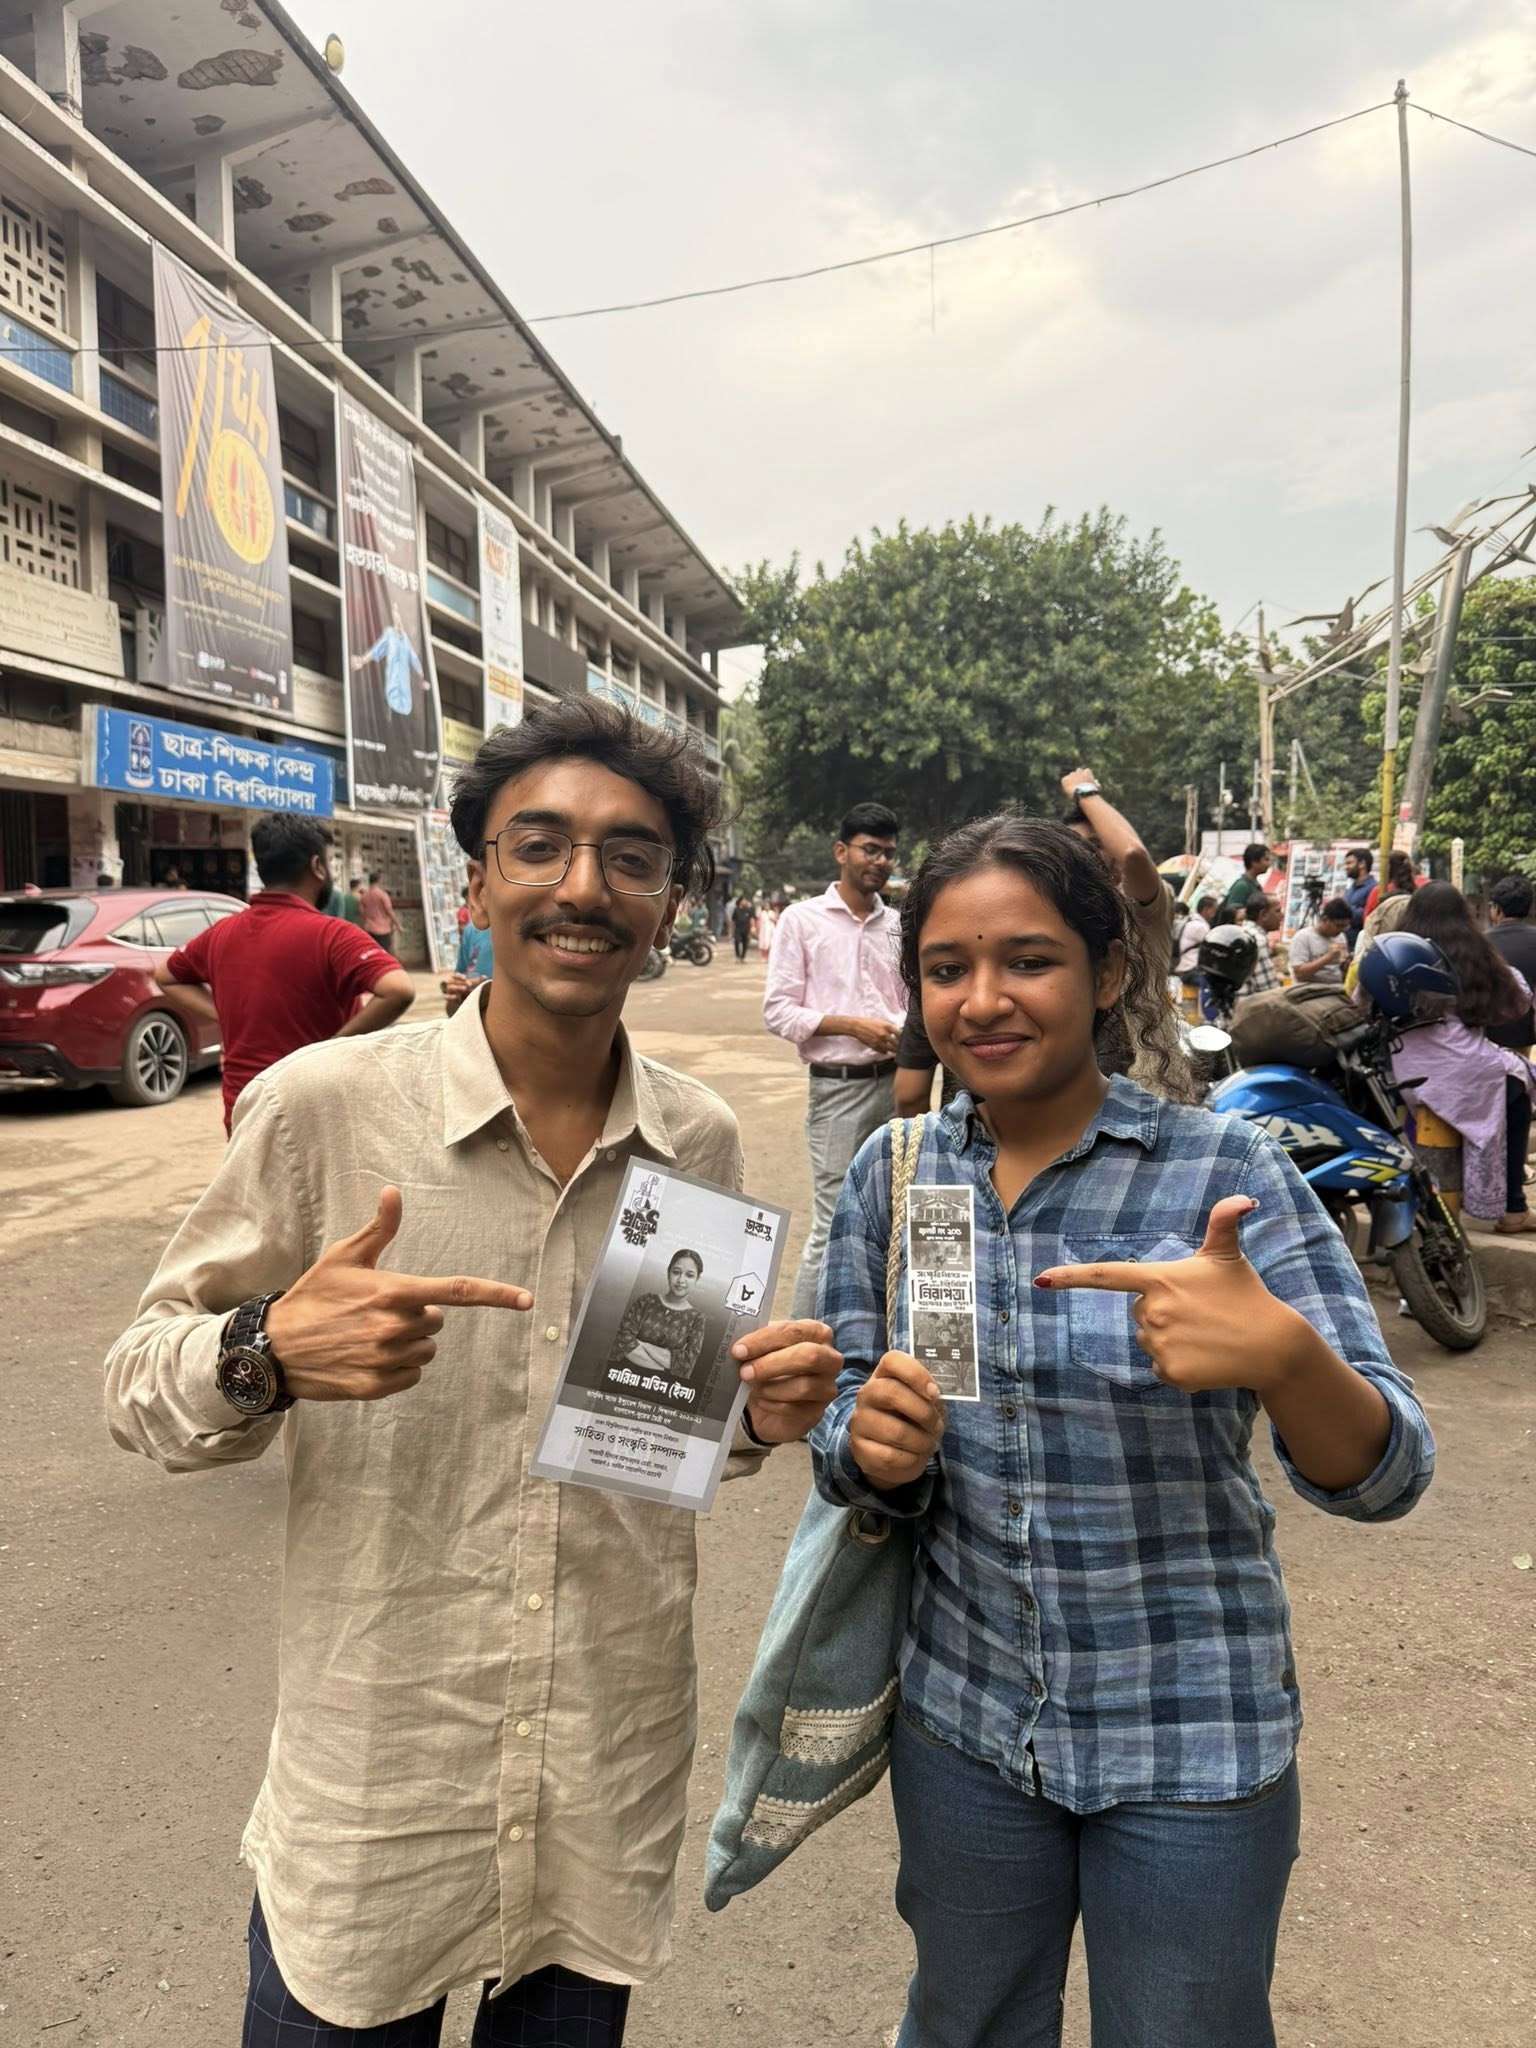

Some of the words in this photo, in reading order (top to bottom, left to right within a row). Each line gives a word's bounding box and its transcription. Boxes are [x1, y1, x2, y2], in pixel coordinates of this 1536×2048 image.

[160, 730, 271, 772] ছাত্র-শিক্ষক
[276, 756, 316, 784] কেন্দ্র
[158, 767, 208, 796] ঢাকা
[213, 770, 317, 811] বিশ্ববিদ্যালয়
[746, 1218, 773, 1242] ডাকসু
[742, 1284, 755, 1302] ৮
[919, 1282, 965, 1301] নিরাপত্তা
[608, 1367, 641, 1387] ফারিয়া
[641, 1374, 668, 1394] মতিন
[668, 1381, 697, 1404] (ইলা)
[574, 1425, 606, 1442] সাহিত্য
[607, 1435, 616, 1443] ও
[618, 1436, 648, 1454] সংস্কৃতি
[649, 1443, 687, 1461] সম্পাদক
